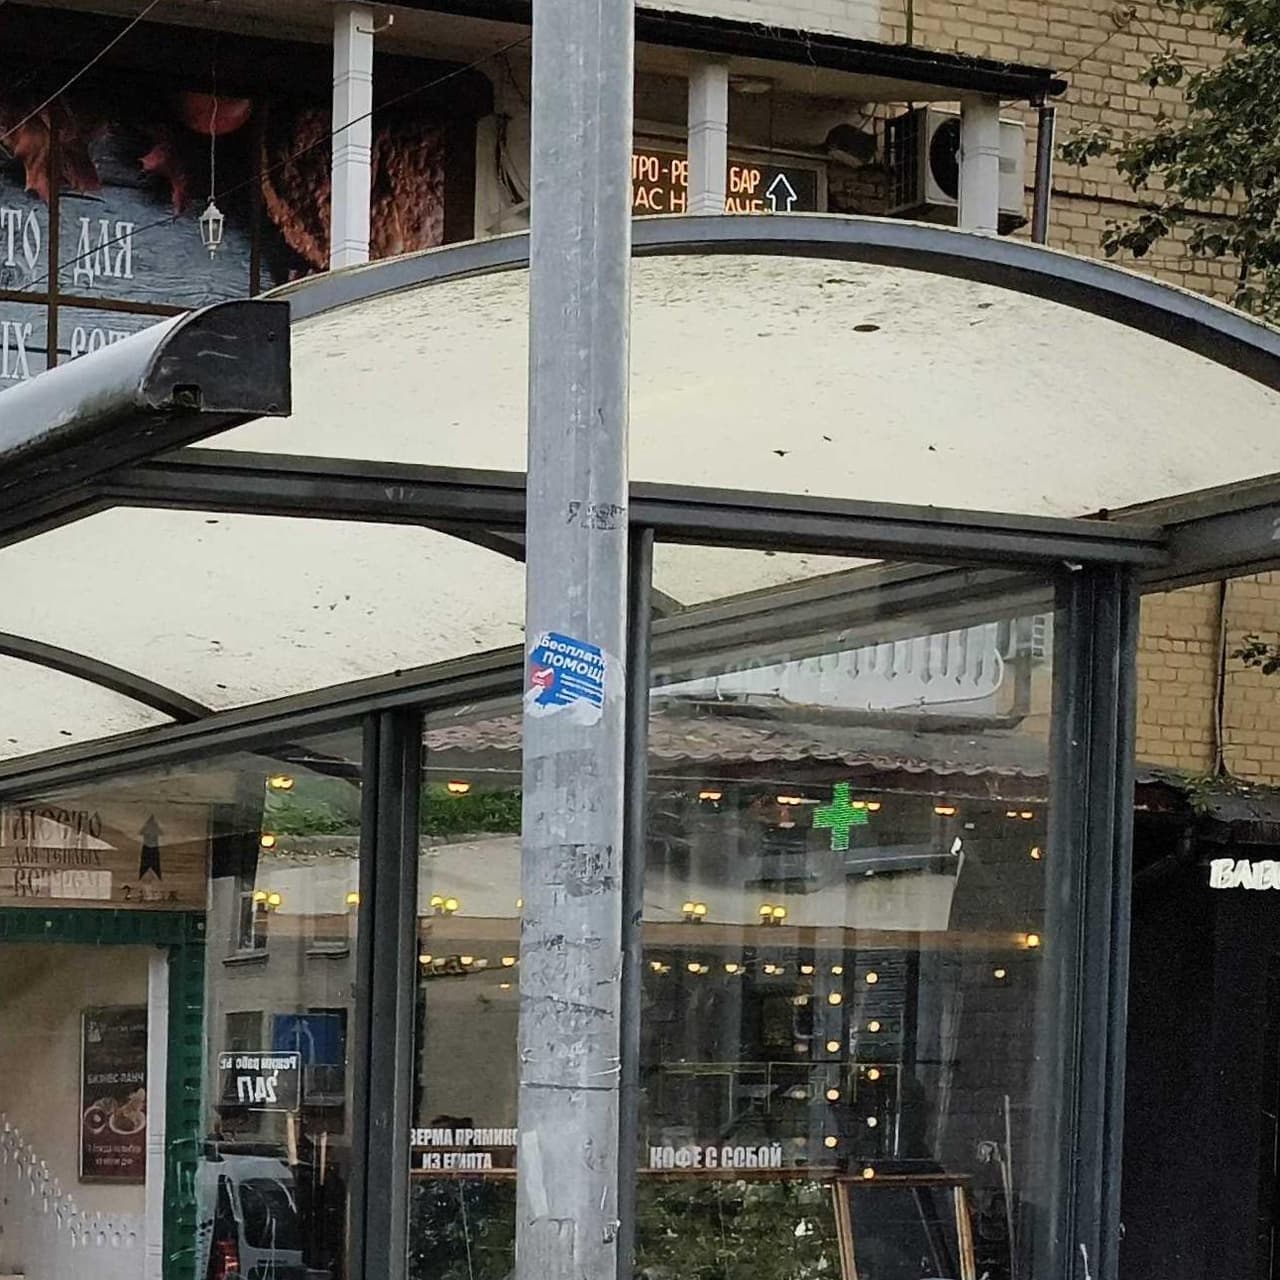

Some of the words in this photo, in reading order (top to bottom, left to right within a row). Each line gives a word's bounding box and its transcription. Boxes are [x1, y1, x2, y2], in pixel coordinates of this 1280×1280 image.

[729, 166, 760, 194] БАР
[74, 216, 134, 288] ДЛЯ
[422, 1152, 441, 1169] ИЗ
[650, 1146, 702, 1169] КОФЕ
[705, 1146, 718, 1169] С
[721, 1142, 782, 1169] СОБОЙ
